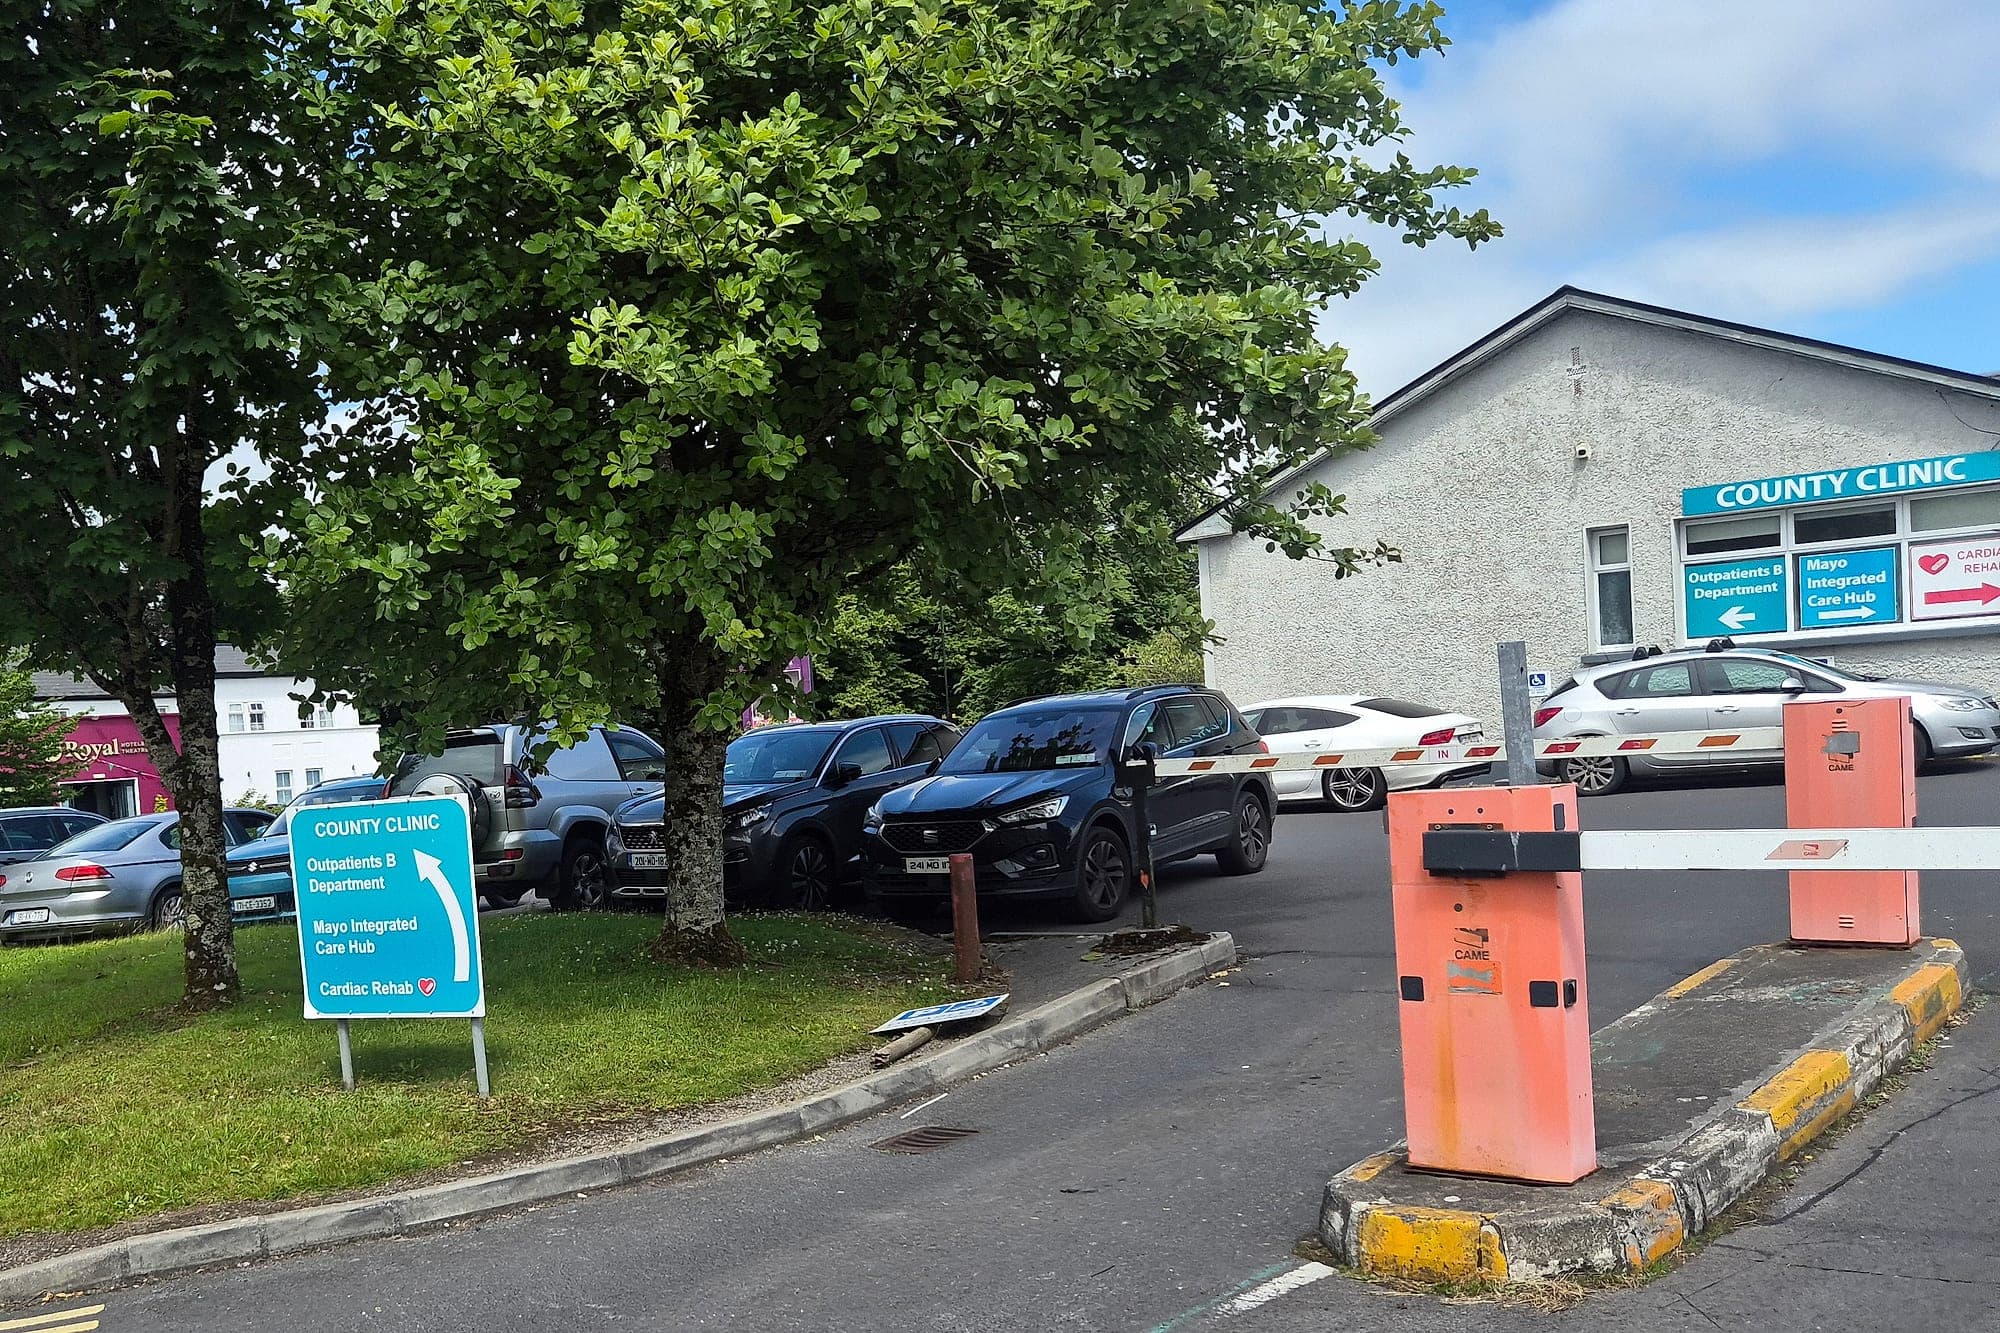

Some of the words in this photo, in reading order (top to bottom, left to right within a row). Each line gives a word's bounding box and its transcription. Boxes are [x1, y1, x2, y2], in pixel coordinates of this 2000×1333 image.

[1716, 471, 1848, 507] COUNTY
[1856, 457, 1967, 491] CLINIC
[1688, 566, 1770, 583] Outpatients
[1773, 564, 1783, 576] B
[1806, 558, 1848, 572] Mayo
[1964, 561, 2000, 574] REHA
[1807, 570, 1887, 589] Integrated
[1694, 582, 1778, 599] Department
[1807, 594, 1841, 607] Care
[1844, 590, 1876, 604] Hub
[62, 738, 120, 761] Royal
[1437, 749, 1449, 759] IN
[314, 817, 382, 838] COUNTY
[385, 814, 440, 833] CLINIC
[307, 855, 383, 874] Outpatients
[386, 853, 397, 868] B
[309, 877, 385, 894] Department
[313, 919, 348, 936] Mayo
[351, 916, 418, 935] Integrated
[315, 940, 346, 955] Care
[349, 939, 376, 954] Hub
[1454, 949, 1490, 960] CAME
[319, 981, 369, 996] Cardiac
[371, 979, 414, 995] Rehab
